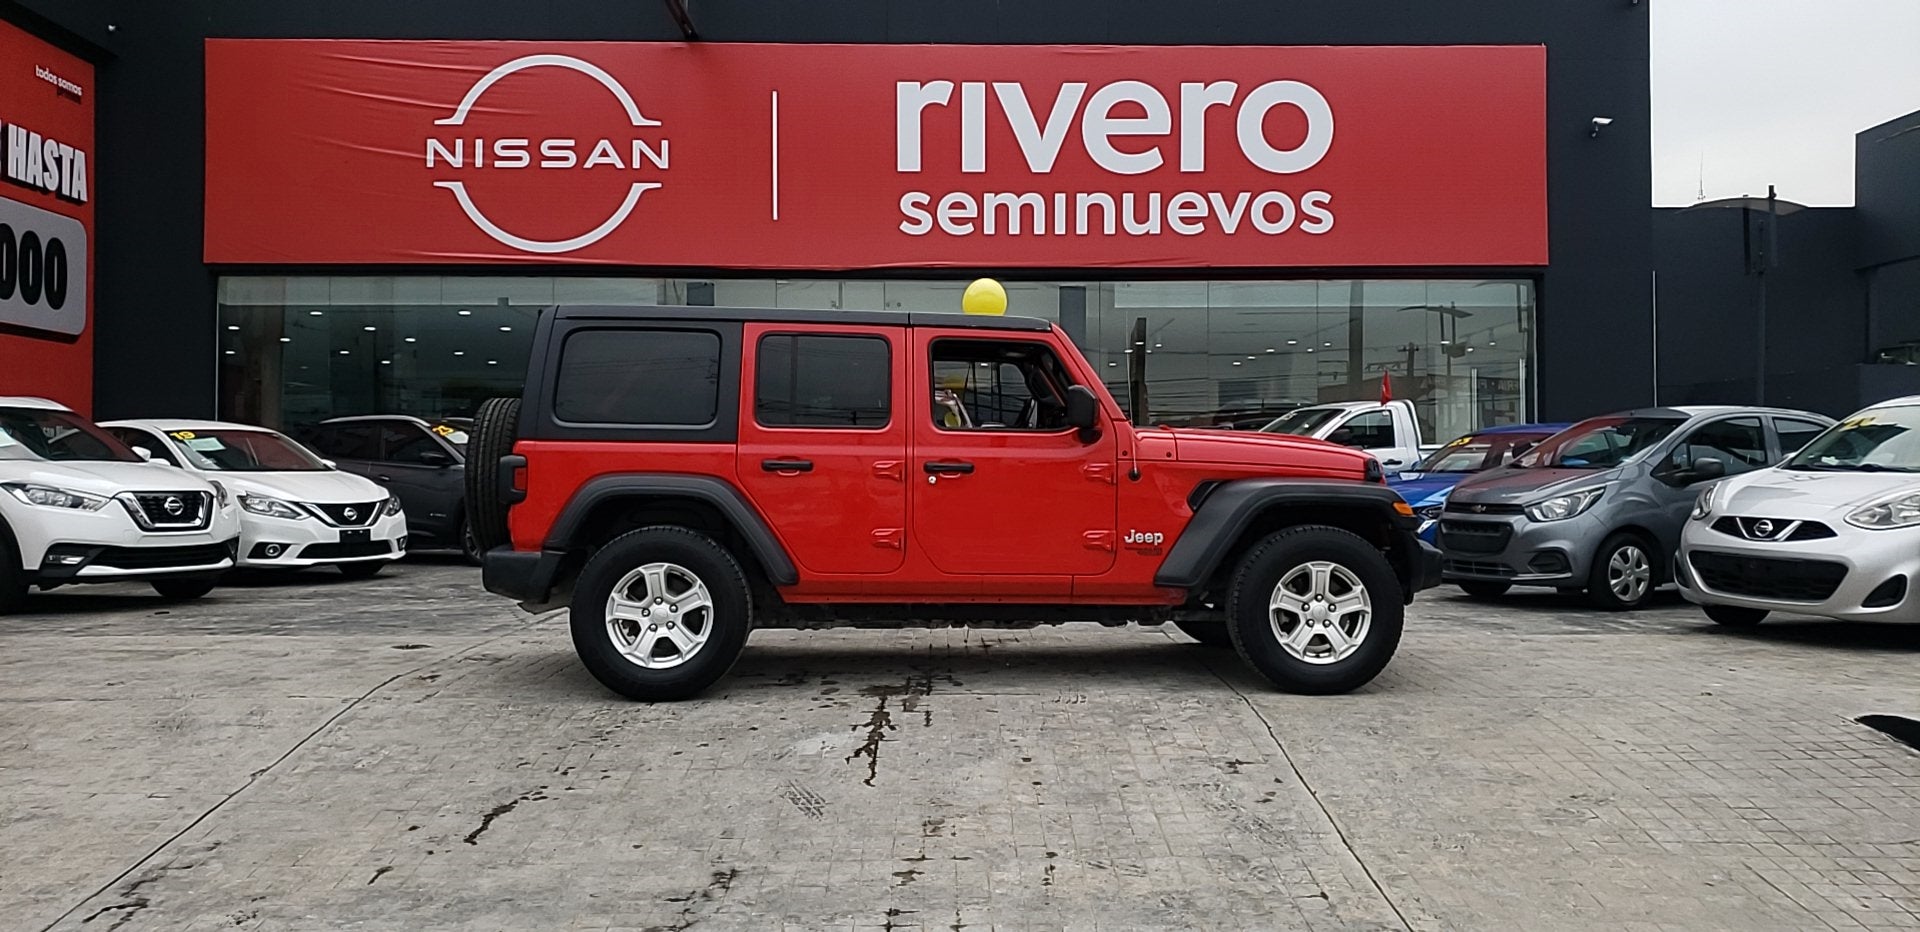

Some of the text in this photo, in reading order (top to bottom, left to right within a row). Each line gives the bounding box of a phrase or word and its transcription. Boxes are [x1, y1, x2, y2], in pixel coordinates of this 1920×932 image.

[35, 64, 82, 96] todos somos
[896, 80, 1335, 174] rivero
[7, 122, 88, 202] HASTA
[425, 138, 670, 169] NISSAN
[899, 190, 1335, 236] seminuevos
[169, 430, 196, 441] 19
[1123, 529, 1164, 546] Jeep
